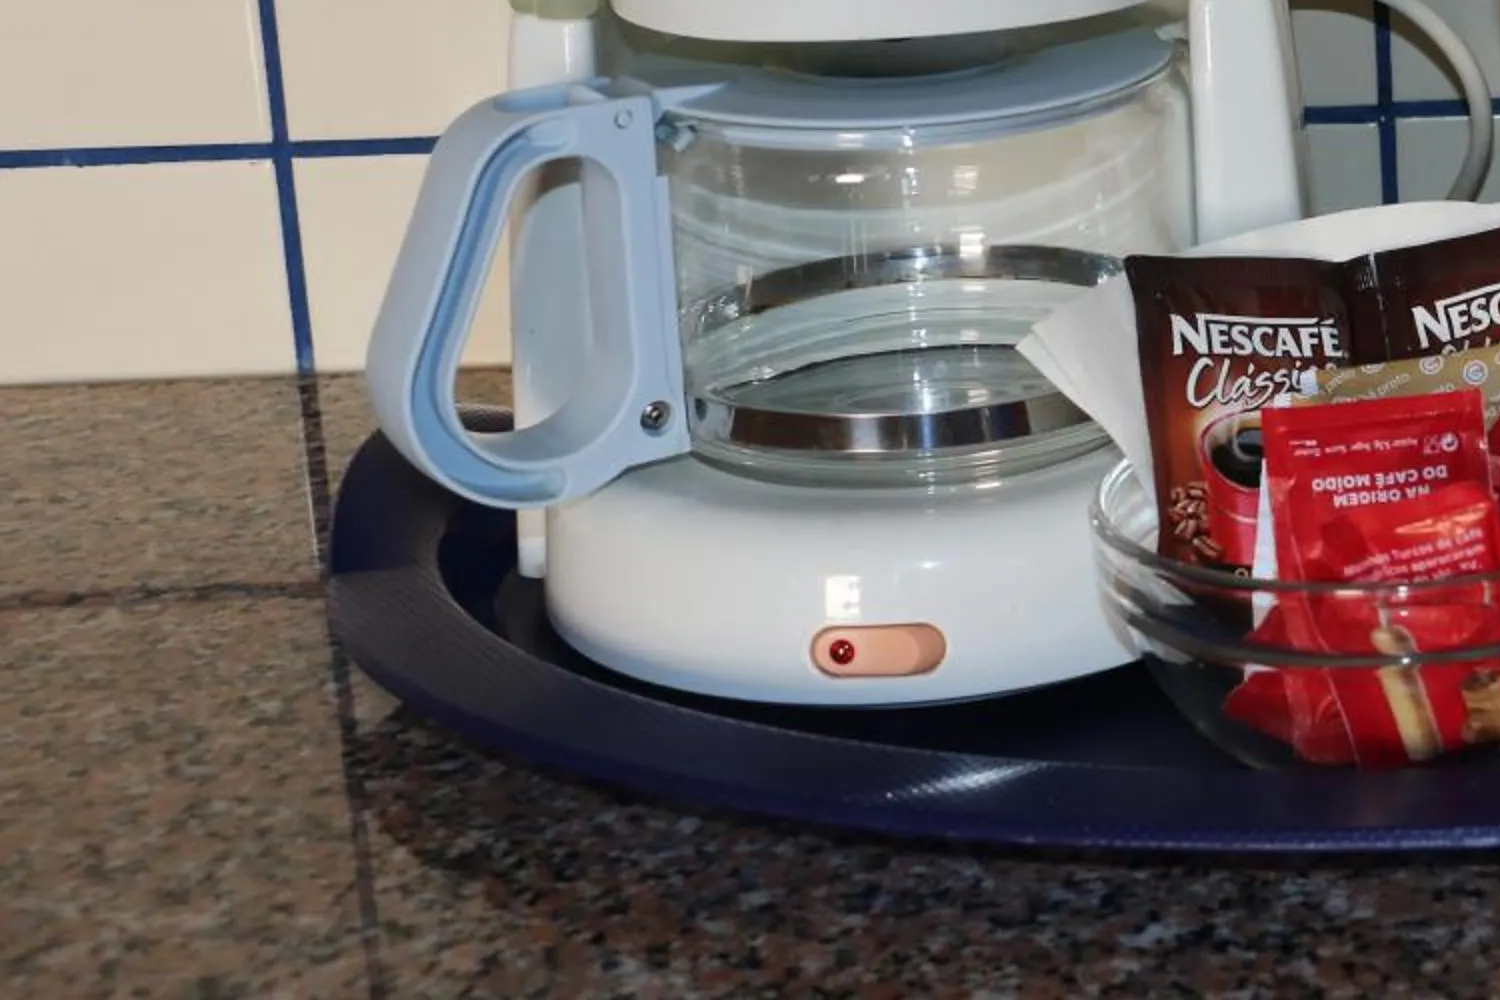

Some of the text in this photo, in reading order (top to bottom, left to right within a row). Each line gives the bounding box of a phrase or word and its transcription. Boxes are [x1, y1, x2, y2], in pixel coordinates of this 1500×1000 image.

[1169, 312, 1344, 358] NESCAFÉ
[1186, 356, 1338, 410] Clássi
[1311, 464, 1448, 494] DO CAFÉ MOÍDO
[1332, 483, 1431, 510] NA ORIGEM
